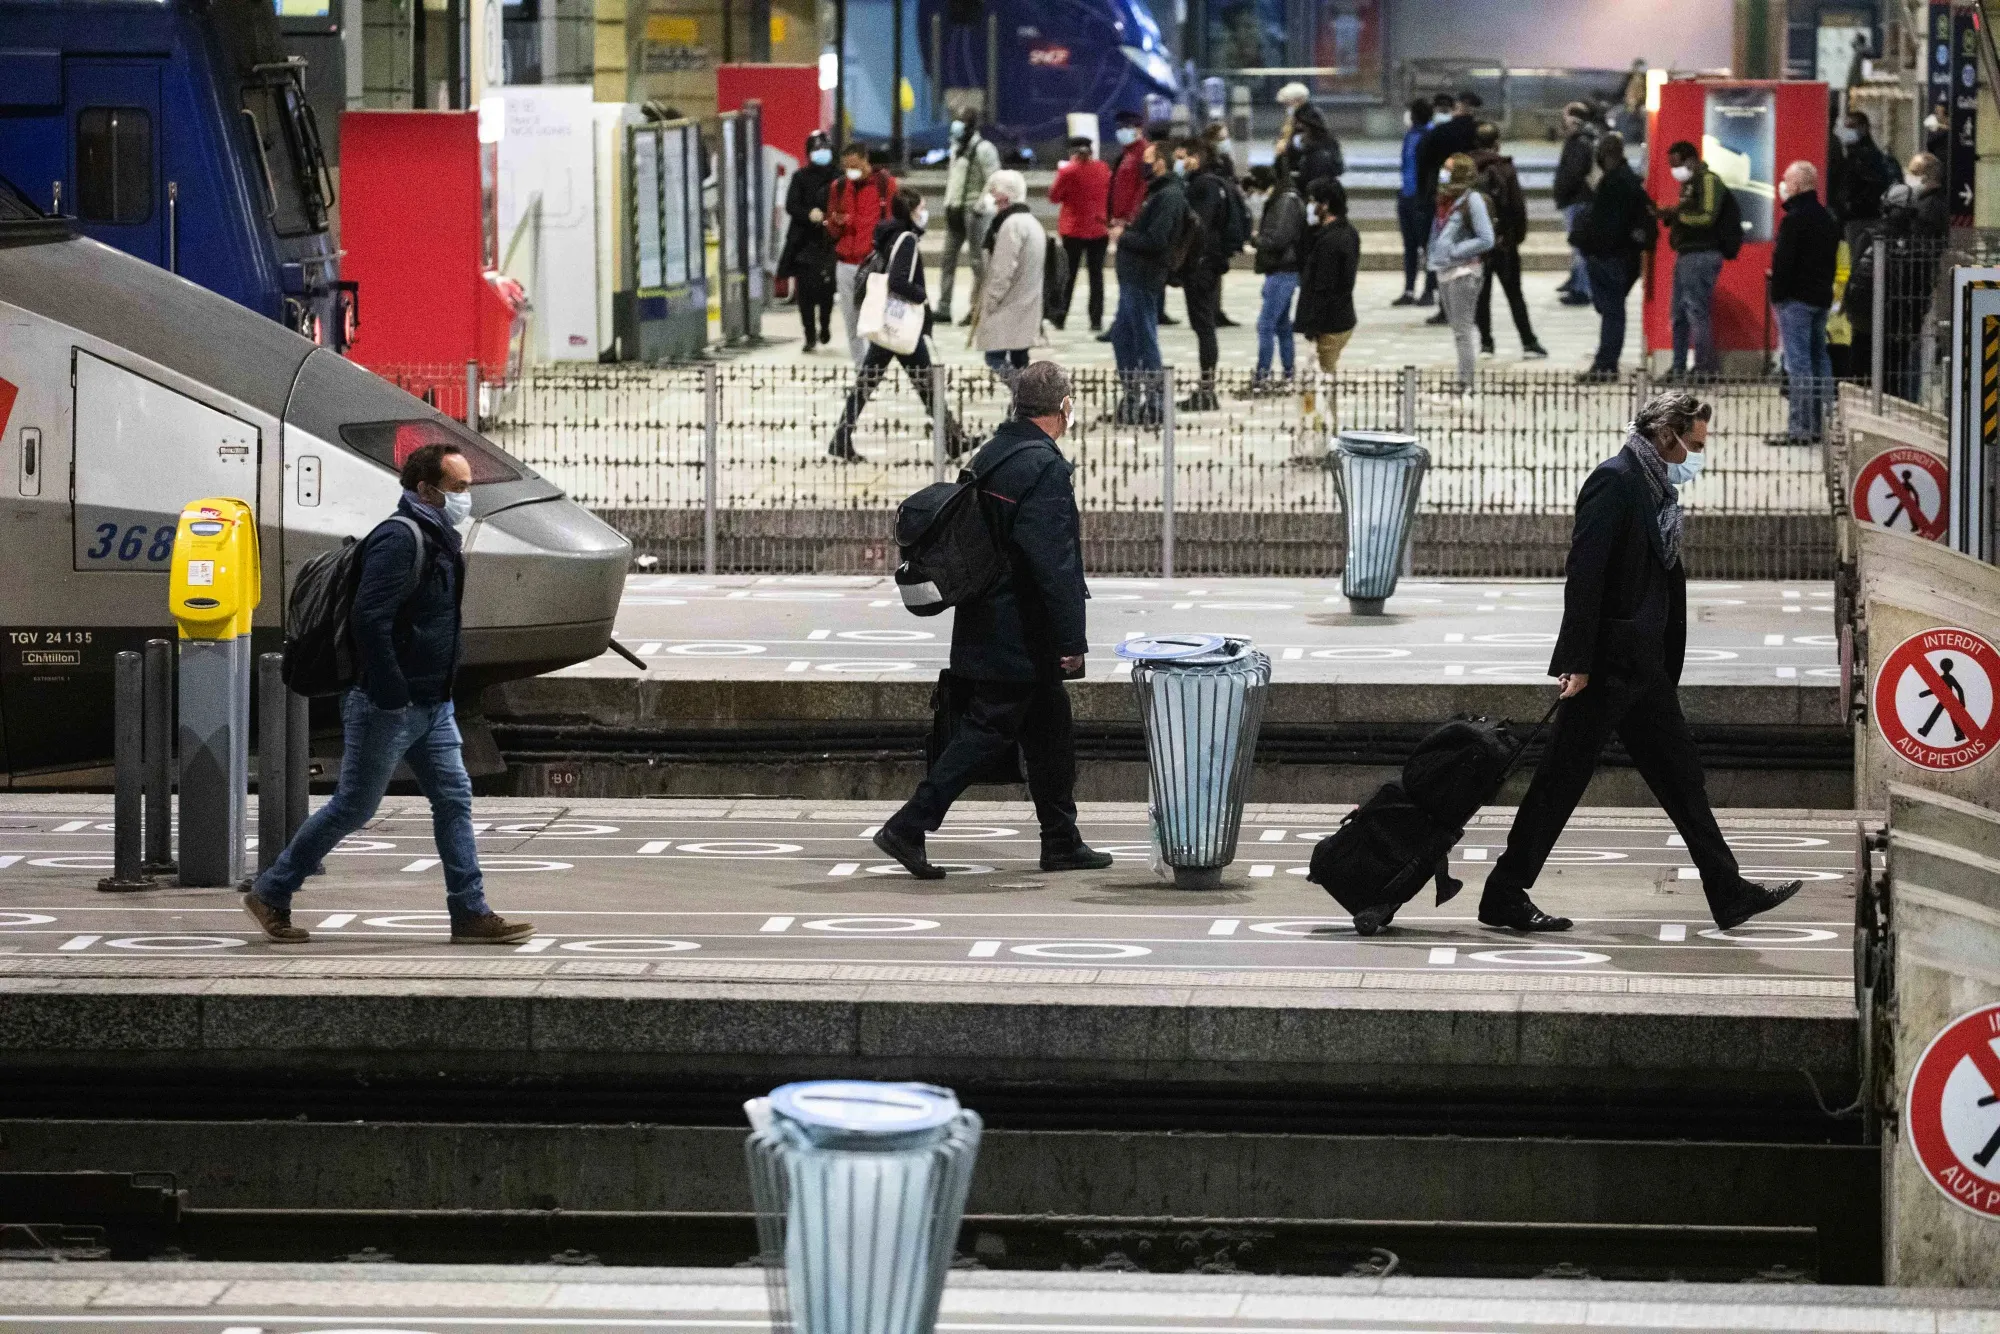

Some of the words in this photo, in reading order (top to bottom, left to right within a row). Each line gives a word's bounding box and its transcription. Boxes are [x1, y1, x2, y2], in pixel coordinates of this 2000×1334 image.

[1888, 450, 1936, 469] INTERDIT
[87, 522, 176, 562] 368
[9, 632, 38, 644] TGV
[1923, 633, 1985, 655] INTERDIT
[27, 653, 75, 663] Châtillon
[1897, 737, 1926, 761] AUX
[1927, 739, 1986, 766] PIETONS
[1940, 1166, 1984, 1204] AUX
